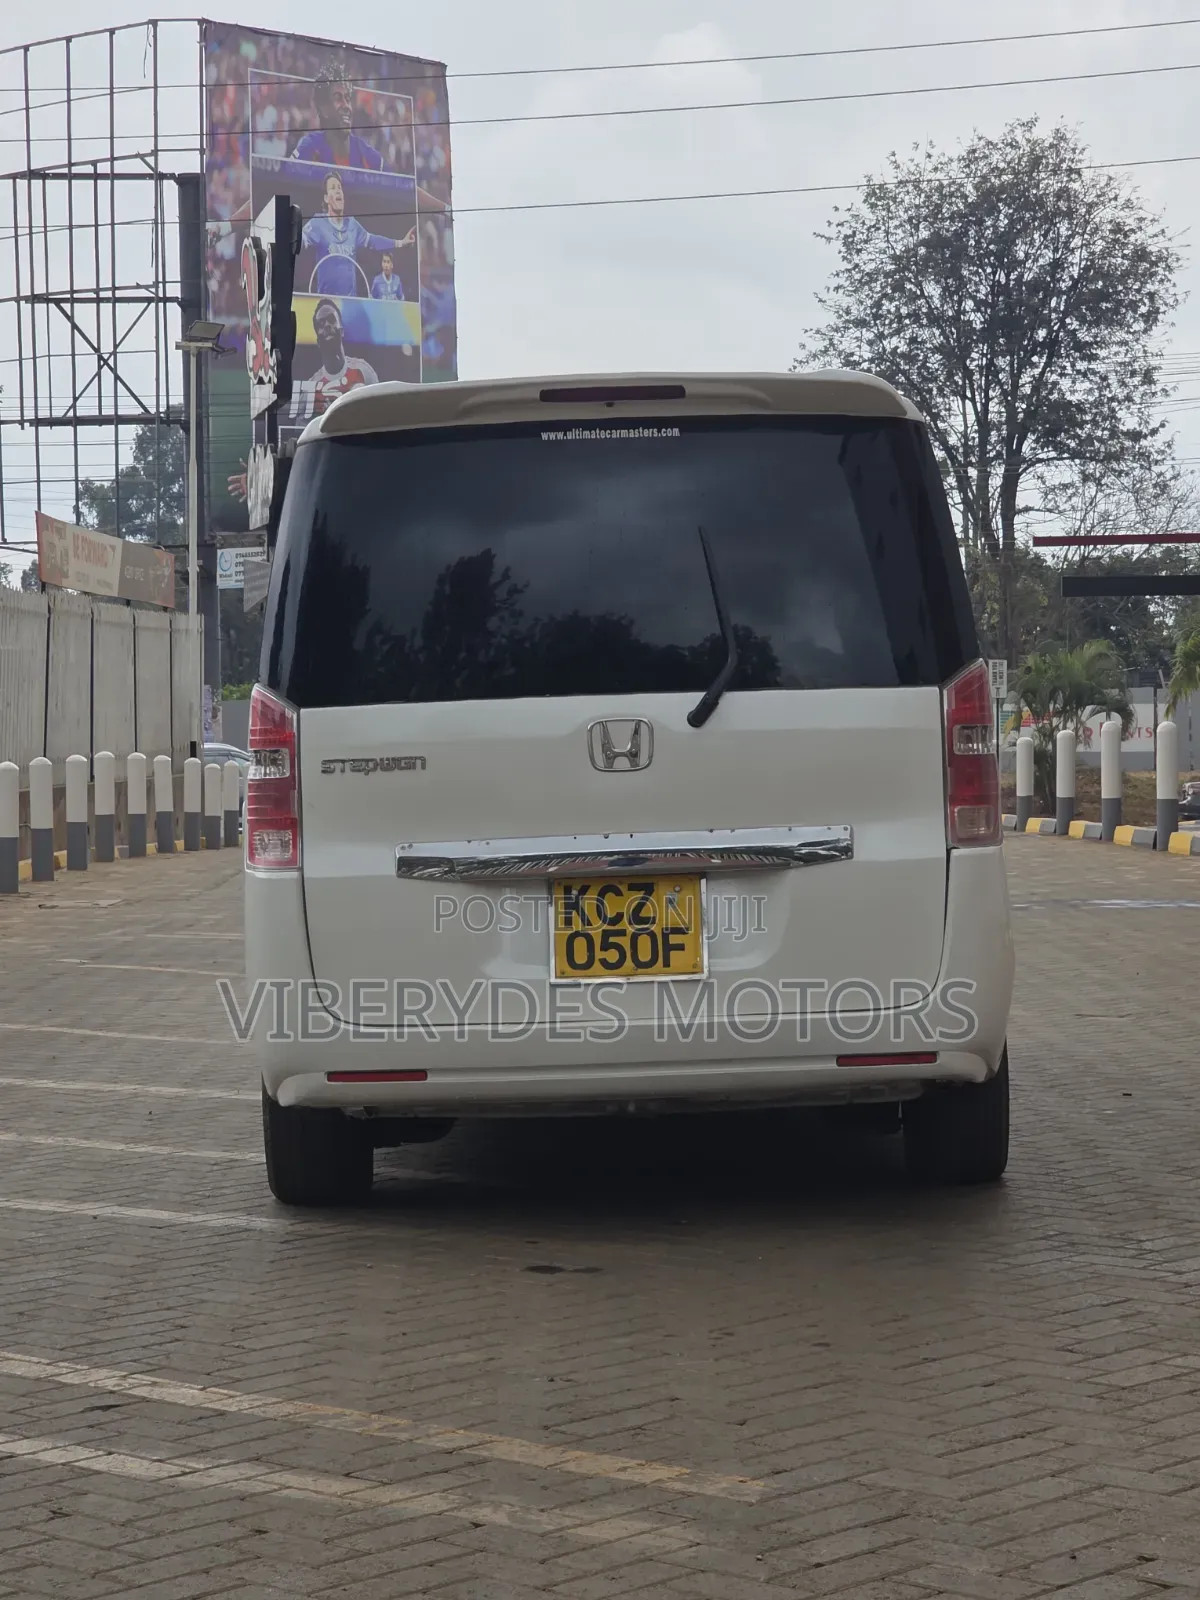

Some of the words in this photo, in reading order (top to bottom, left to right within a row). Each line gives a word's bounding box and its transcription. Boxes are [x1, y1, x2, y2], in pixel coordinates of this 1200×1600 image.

[541, 427, 681, 441] www.ultimatecarmasters.com
[562, 883, 657, 928] KCZ
[565, 928, 690, 970] 050F
